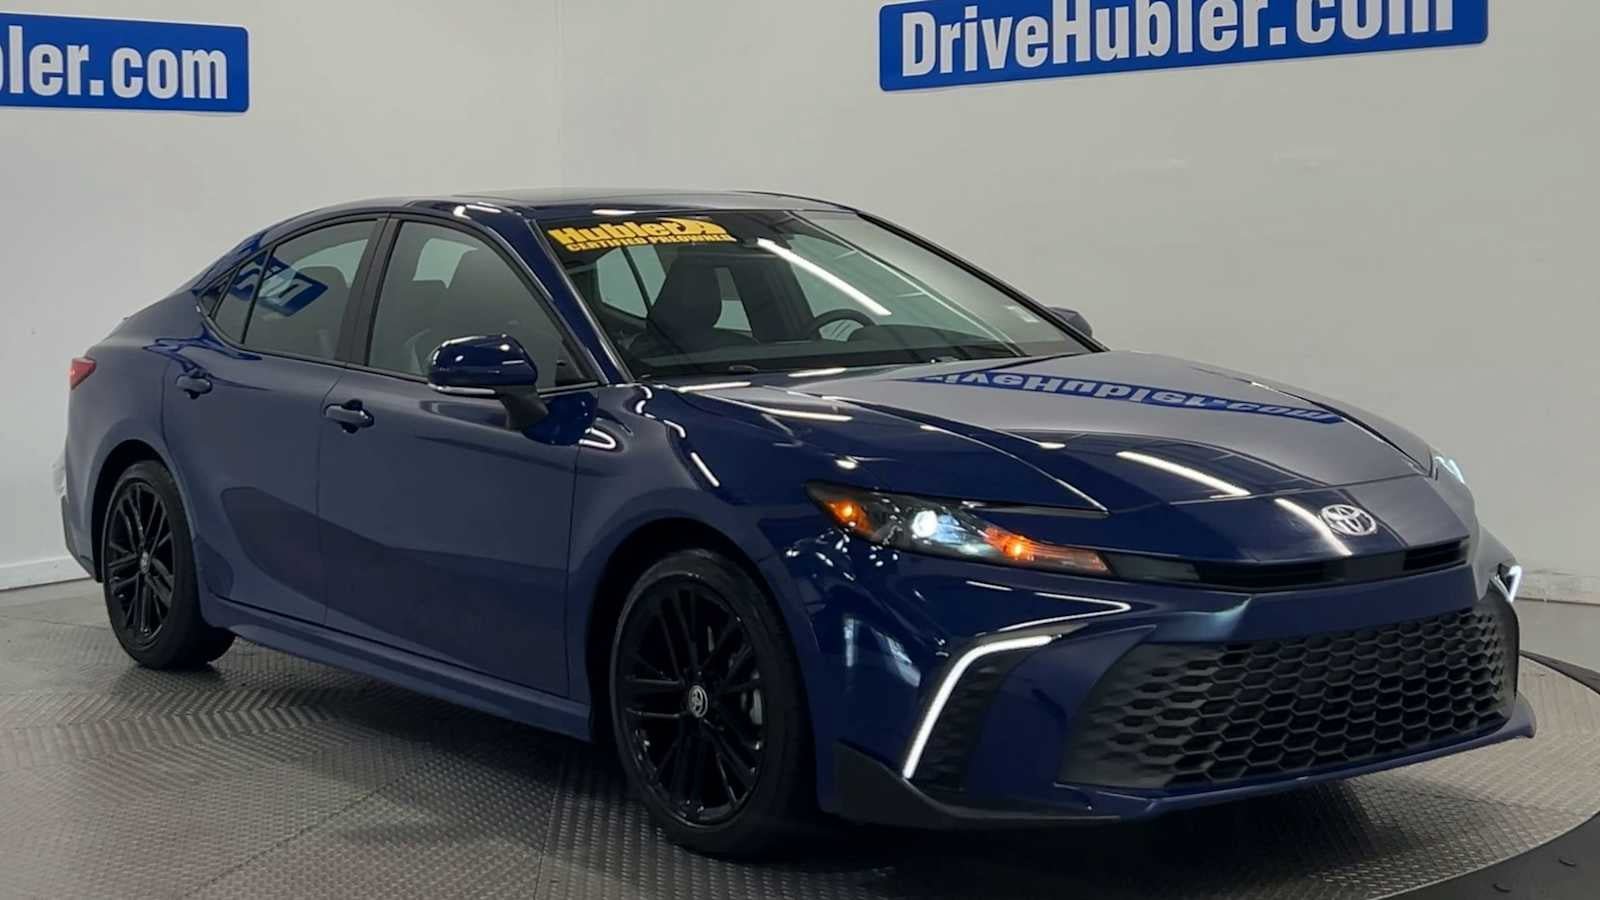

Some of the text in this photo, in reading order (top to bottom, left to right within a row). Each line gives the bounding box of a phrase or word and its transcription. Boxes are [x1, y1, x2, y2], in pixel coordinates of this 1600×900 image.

[0, 25, 228, 100] ler.com
[901, 0, 1453, 77] DriveHubler.com
[548, 220, 687, 246] Hubler
[566, 236, 649, 252] CERTIFIED
